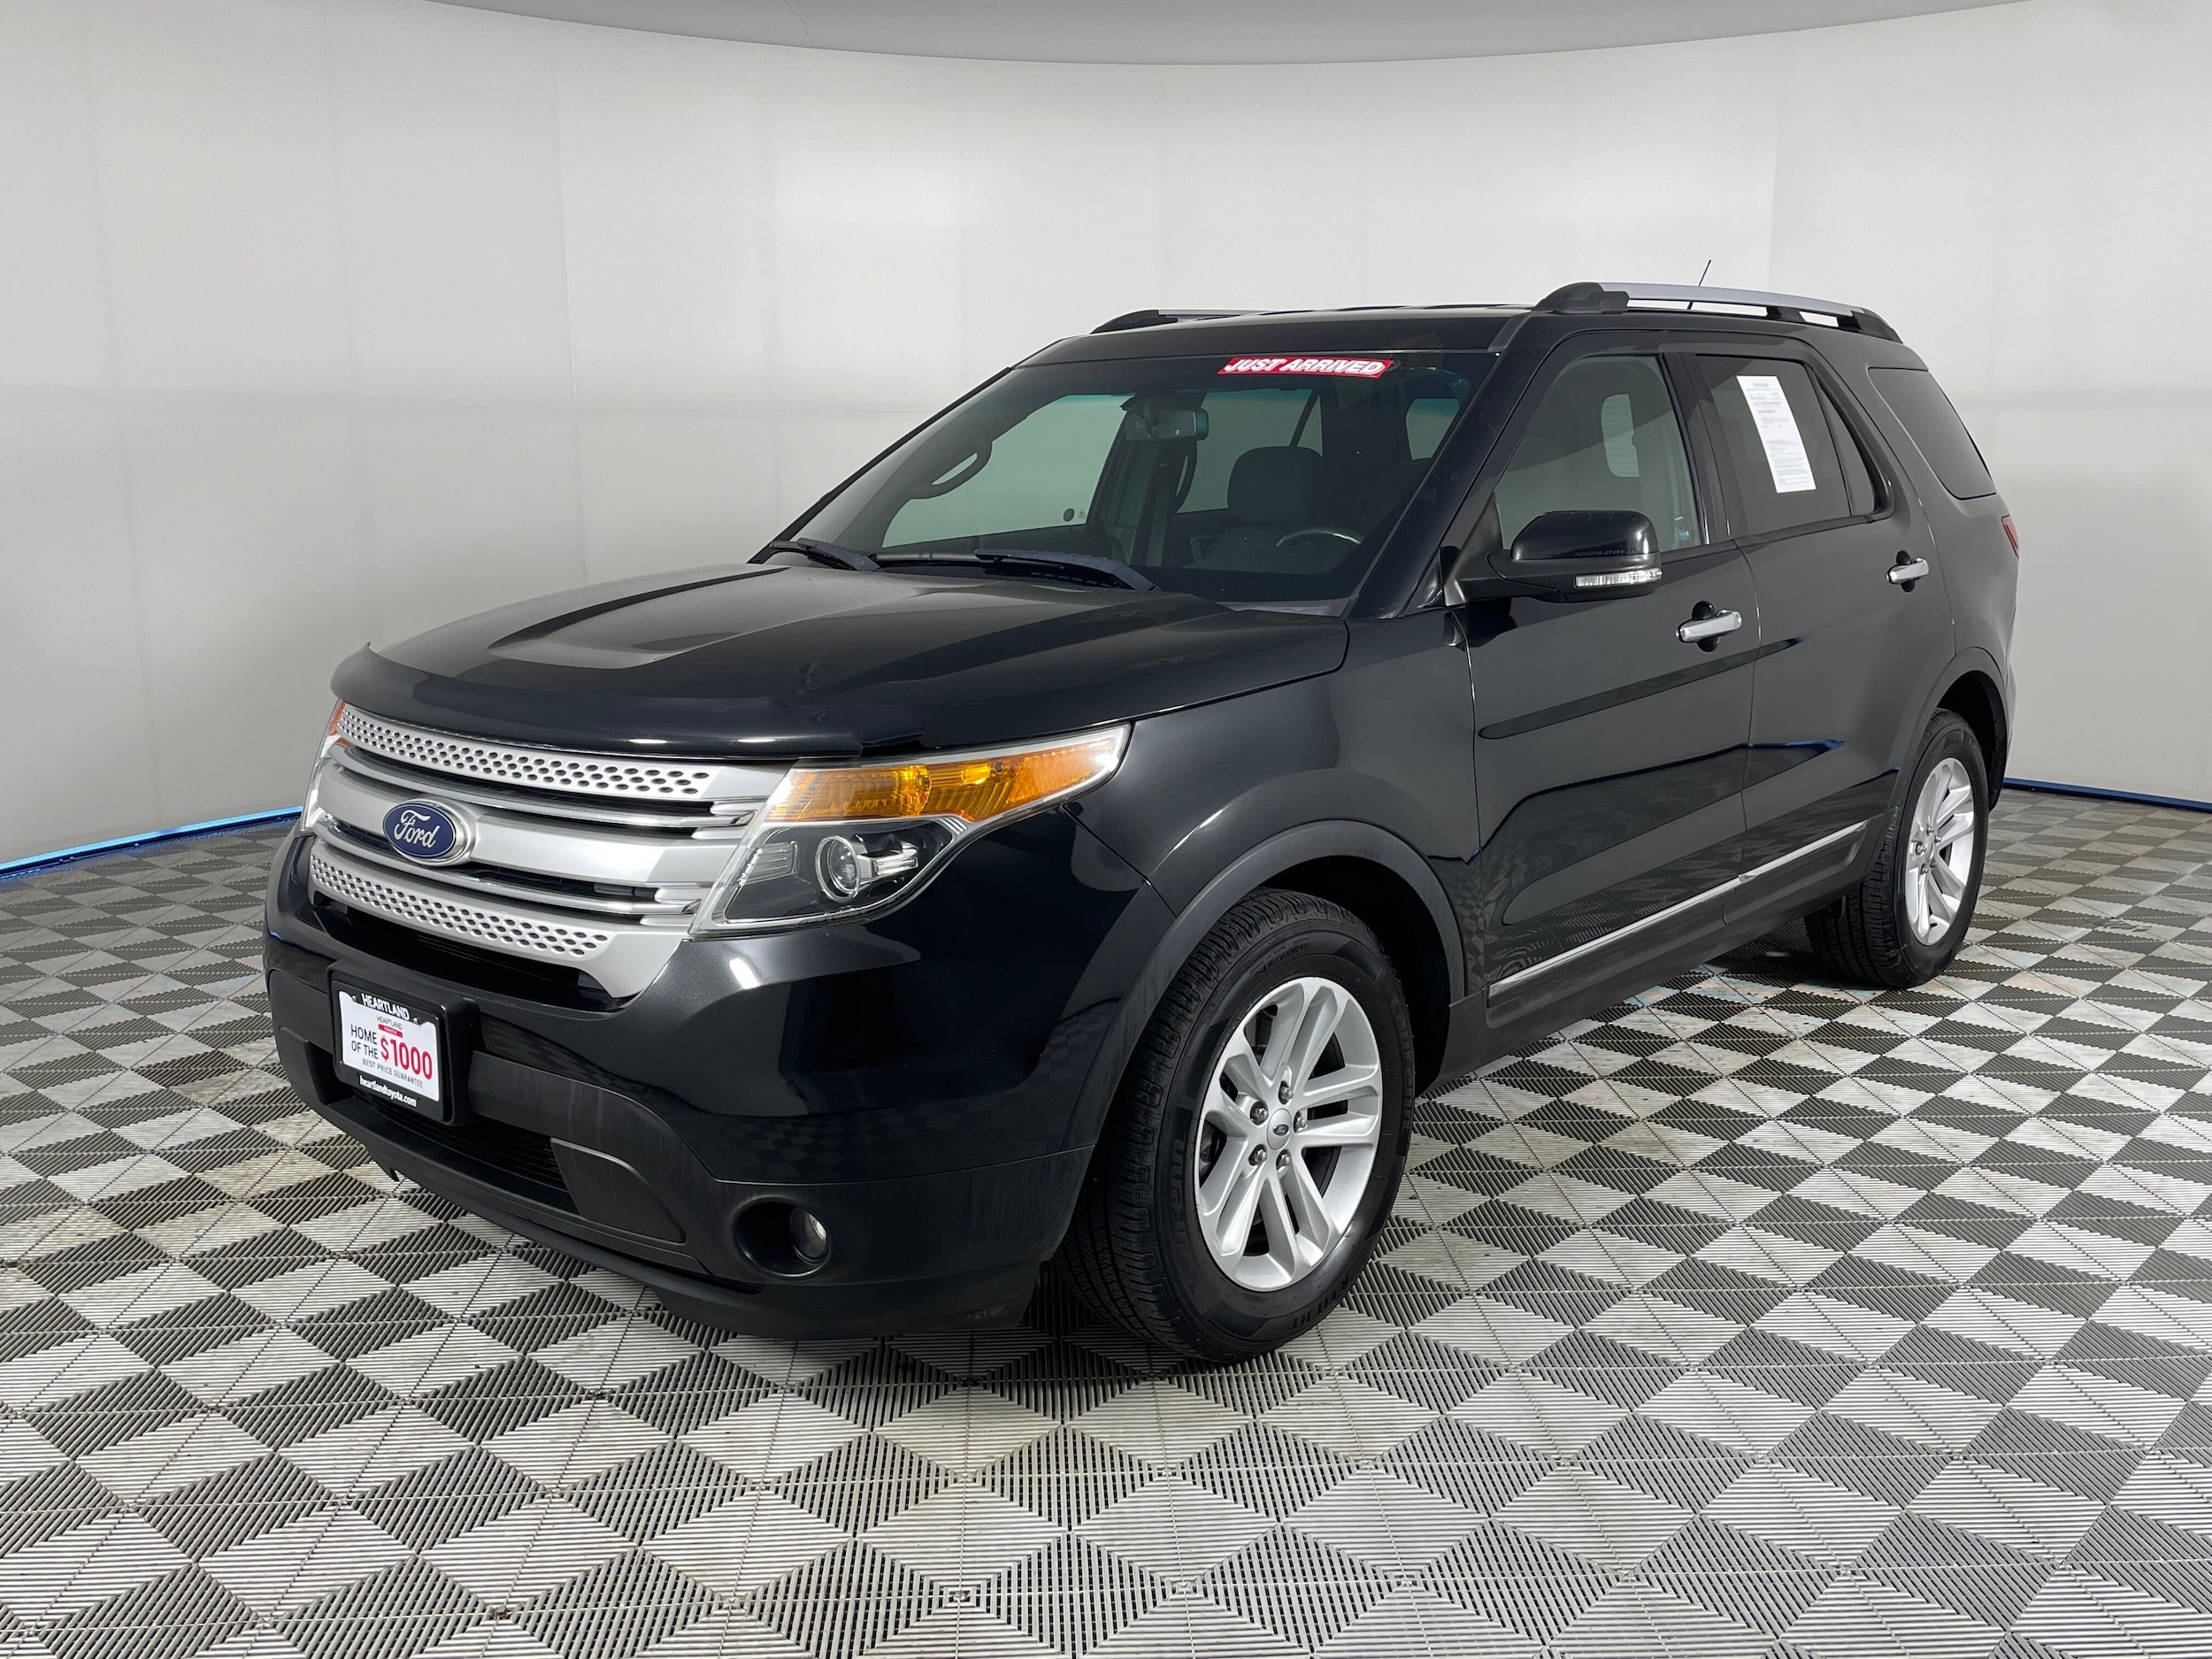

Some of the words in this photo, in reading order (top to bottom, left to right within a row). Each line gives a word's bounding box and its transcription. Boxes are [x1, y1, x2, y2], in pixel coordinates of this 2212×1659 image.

[1224, 358, 1286, 373] JUST
[1279, 358, 1386, 374] ARRIVED
[394, 810, 441, 848] Ford
[361, 993, 411, 1021] HEARTLAND
[350, 1024, 377, 1045] HOME
[377, 1015, 403, 1031] HEARTLAND
[351, 1041, 362, 1053] OF
[364, 1044, 379, 1060] THE
[380, 1035, 433, 1080] $1000
[362, 1058, 375, 1068] BEST
[377, 1064, 392, 1075] PRICE
[394, 1070, 424, 1088] GUARANTEE
[359, 1075, 417, 1107] heartlandtoyota.com
